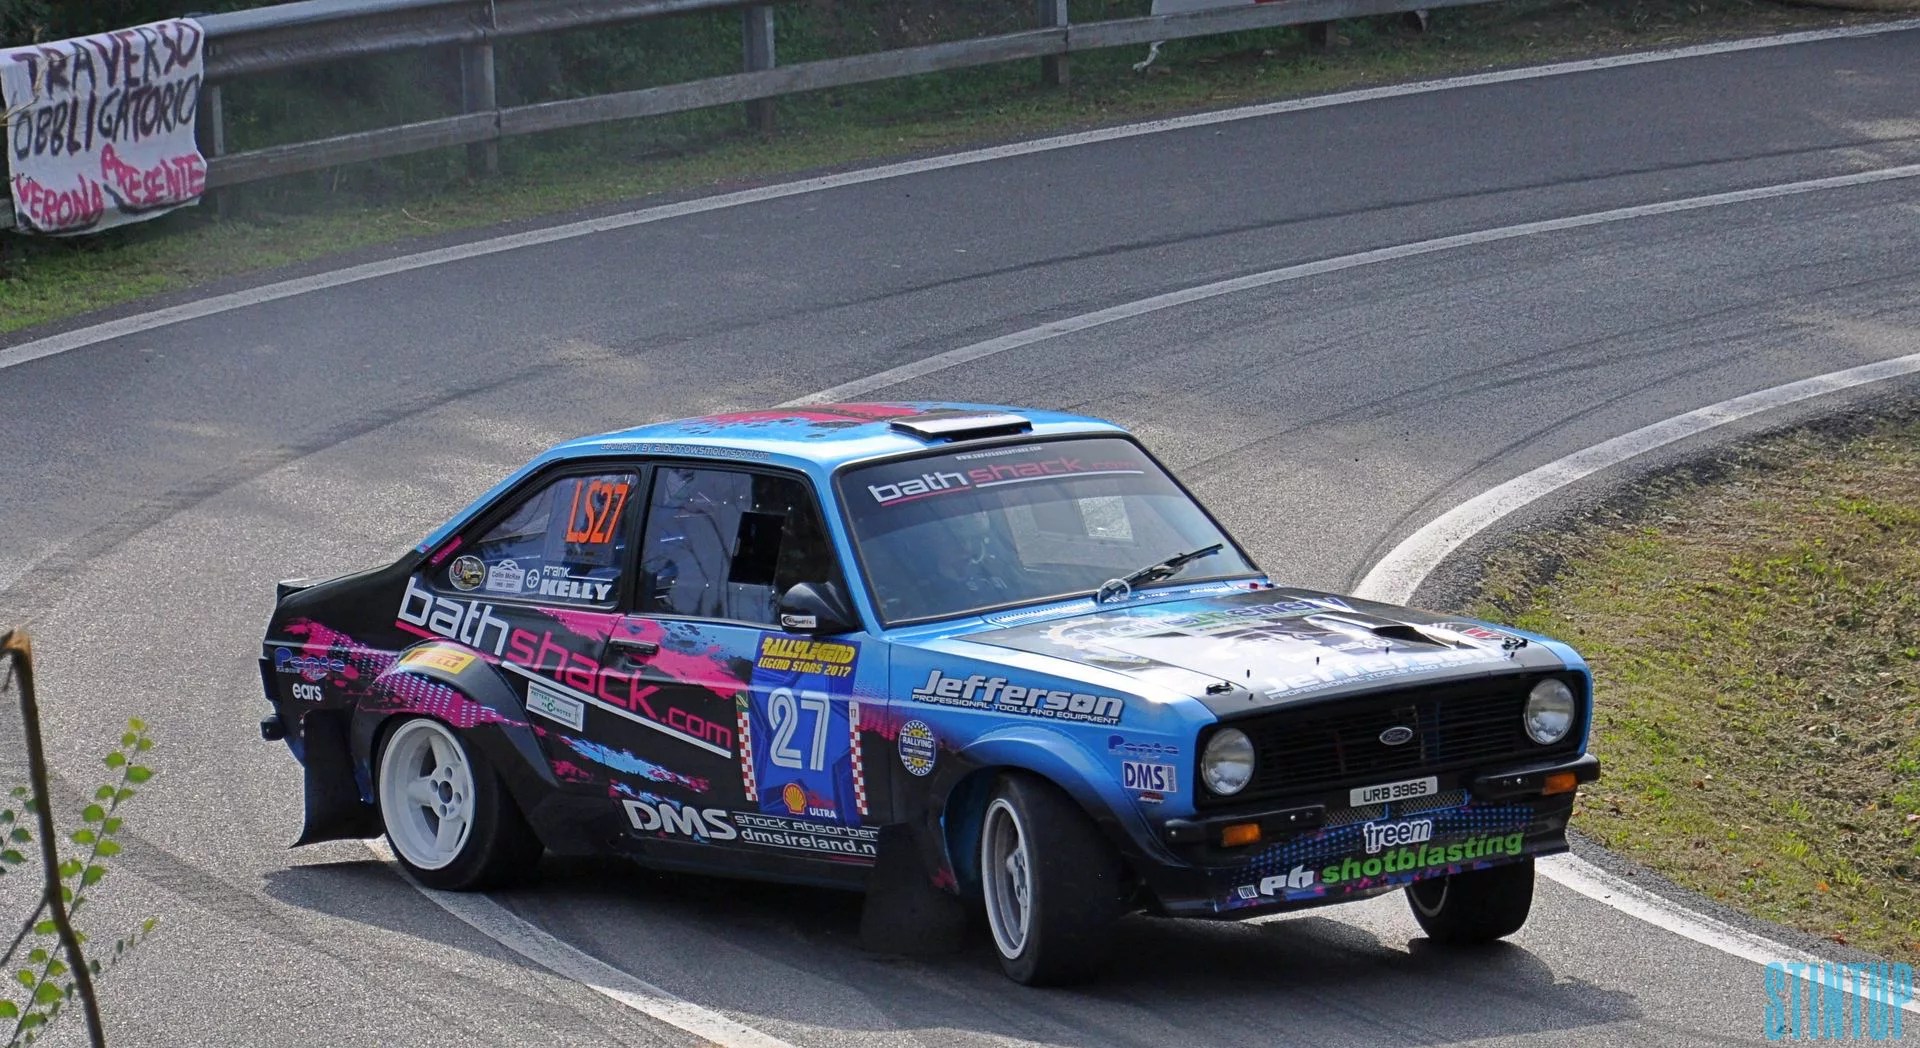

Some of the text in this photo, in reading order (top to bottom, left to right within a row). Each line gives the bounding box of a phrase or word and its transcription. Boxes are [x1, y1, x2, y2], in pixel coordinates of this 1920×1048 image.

[11, 21, 200, 98] TRAVERSO
[14, 74, 200, 160] OBBLIGATORIO
[15, 143, 206, 226] VERONA PRESENTE
[565, 480, 629, 543] LS27
[541, 579, 611, 600] KELLY
[397, 577, 732, 748] bathshack.com
[758, 658, 851, 678] LEGEND STARS 2017
[292, 683, 322, 701] ears
[913, 671, 1123, 717] Jefferson
[912, 695, 1120, 725] PROFESSIONAL TOOLS AND EQUIPMENT
[768, 687, 830, 771] 27
[902, 736, 932, 749] RALLYING
[1123, 762, 1165, 791] DMS
[1363, 781, 1427, 802] URB 396S
[622, 799, 737, 840] DMS
[734, 814, 789, 829] shock
[809, 807, 837, 819] ULTRA
[1321, 831, 1525, 885] shotblasting
